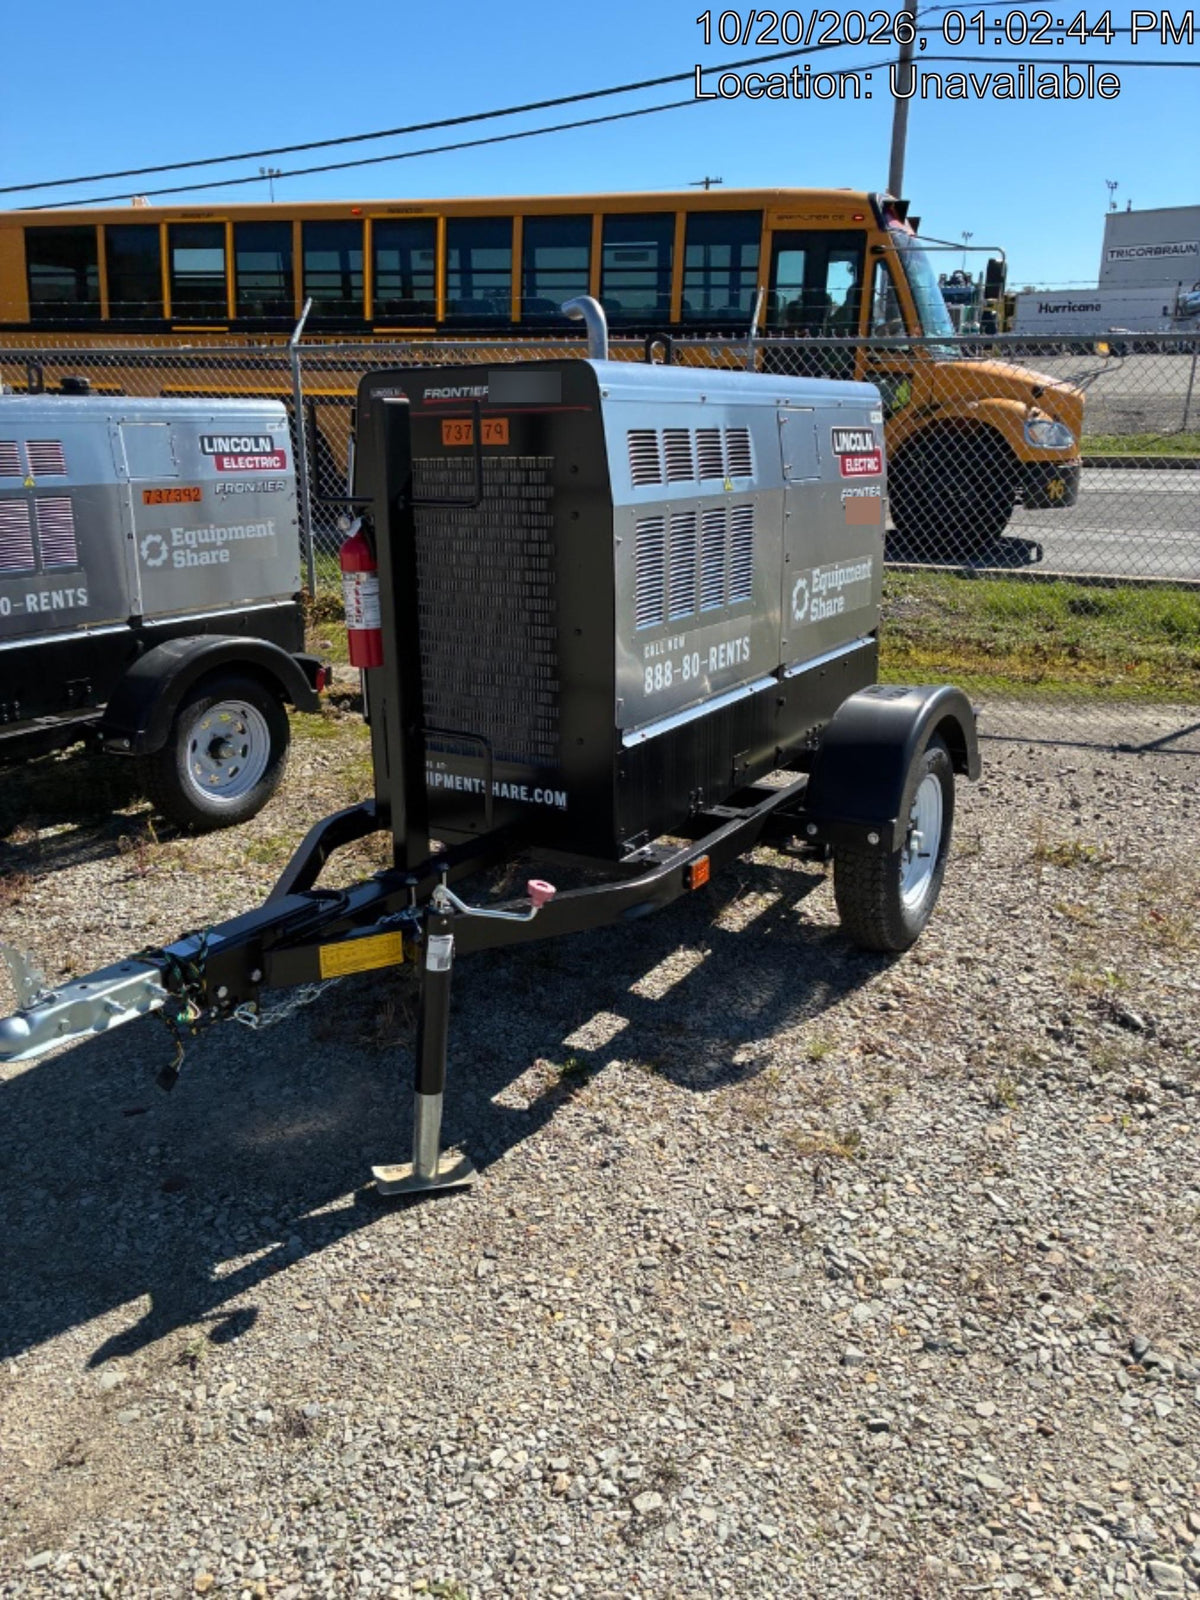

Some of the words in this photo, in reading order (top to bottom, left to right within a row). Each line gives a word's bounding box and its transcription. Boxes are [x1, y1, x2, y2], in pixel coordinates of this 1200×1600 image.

[1109, 243, 1198, 259] TRICORBRAUN
[1038, 301, 1102, 314] Hurricane
[444, 422, 505, 442] 73779
[833, 431, 874, 452] LINCOLN
[203, 437, 271, 452] LINCOLN
[222, 456, 282, 469] ELECTRIC
[845, 457, 879, 473] ELECTRIC
[143, 487, 201, 505] 737392
[215, 480, 286, 495] FRONTIER
[170, 519, 276, 548] Equipment
[172, 548, 230, 568] Share
[811, 560, 873, 596] Equipment
[809, 595, 846, 622] Share
[644, 635, 750, 695] 888-80-RENTS
